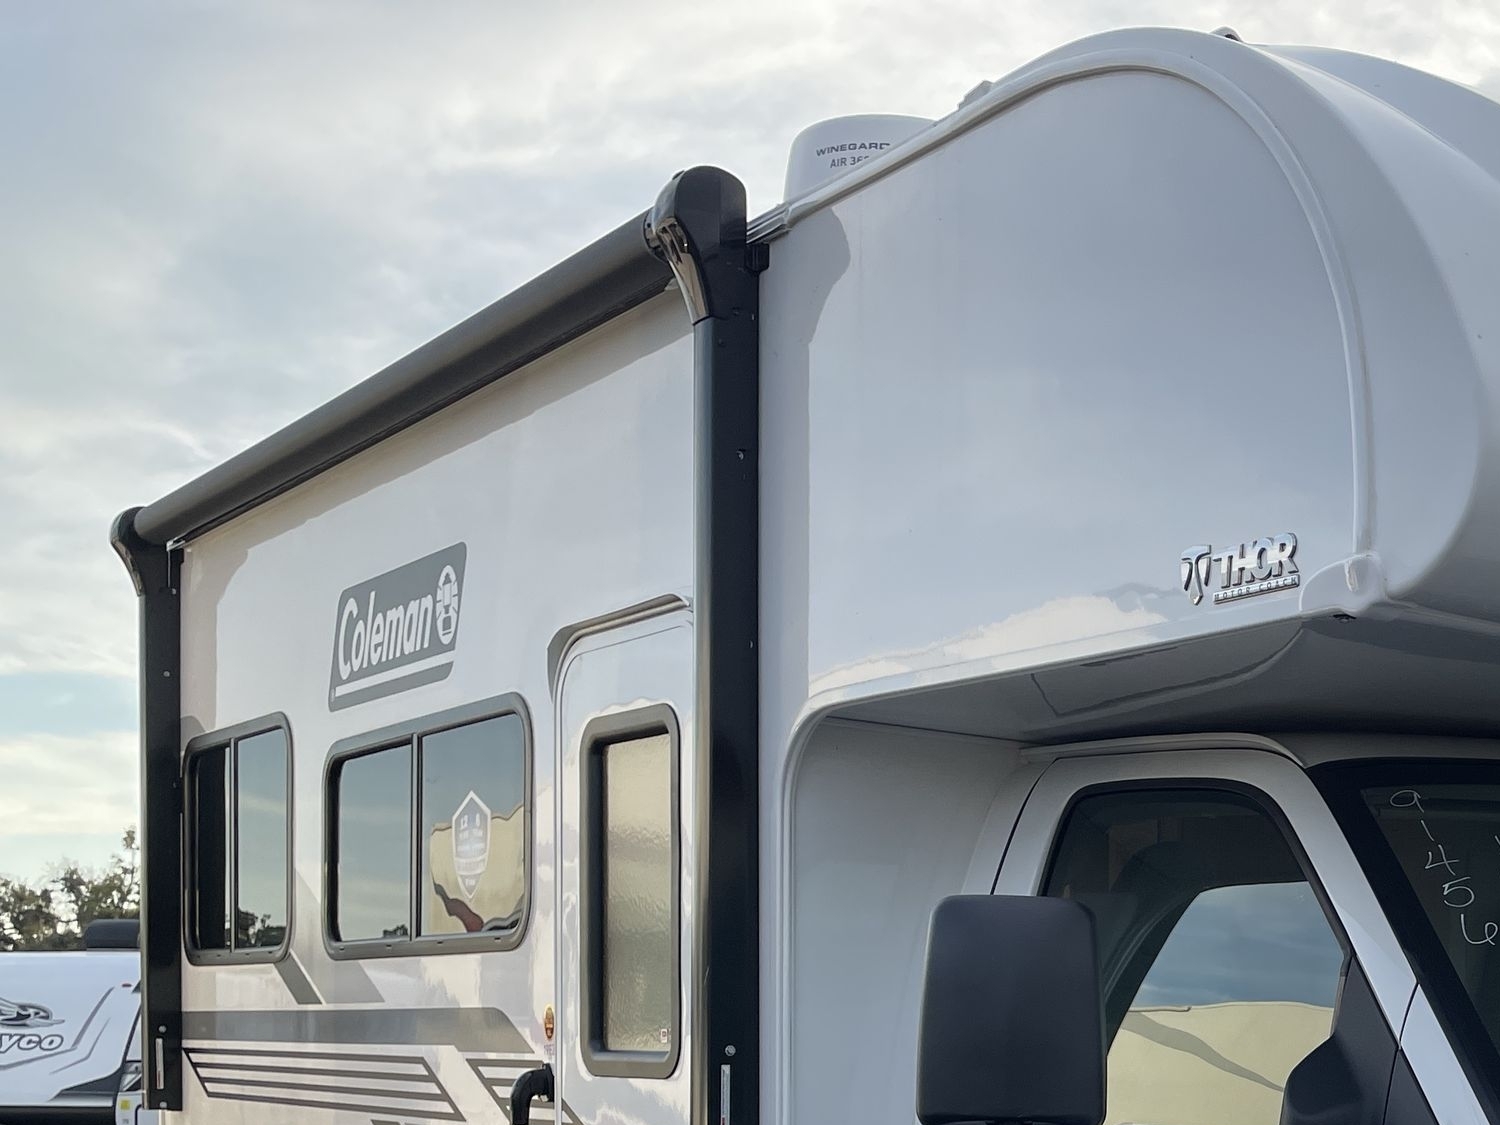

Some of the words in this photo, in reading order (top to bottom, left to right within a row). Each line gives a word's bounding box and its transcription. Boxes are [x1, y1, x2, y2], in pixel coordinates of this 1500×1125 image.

[830, 157, 847, 168] AIR
[850, 155, 869, 166] 36
[1212, 532, 1299, 590] THOR
[1213, 586, 1251, 601] MOTOR
[338, 590, 434, 681] Coleman
[0, 1033, 64, 1053] yco
